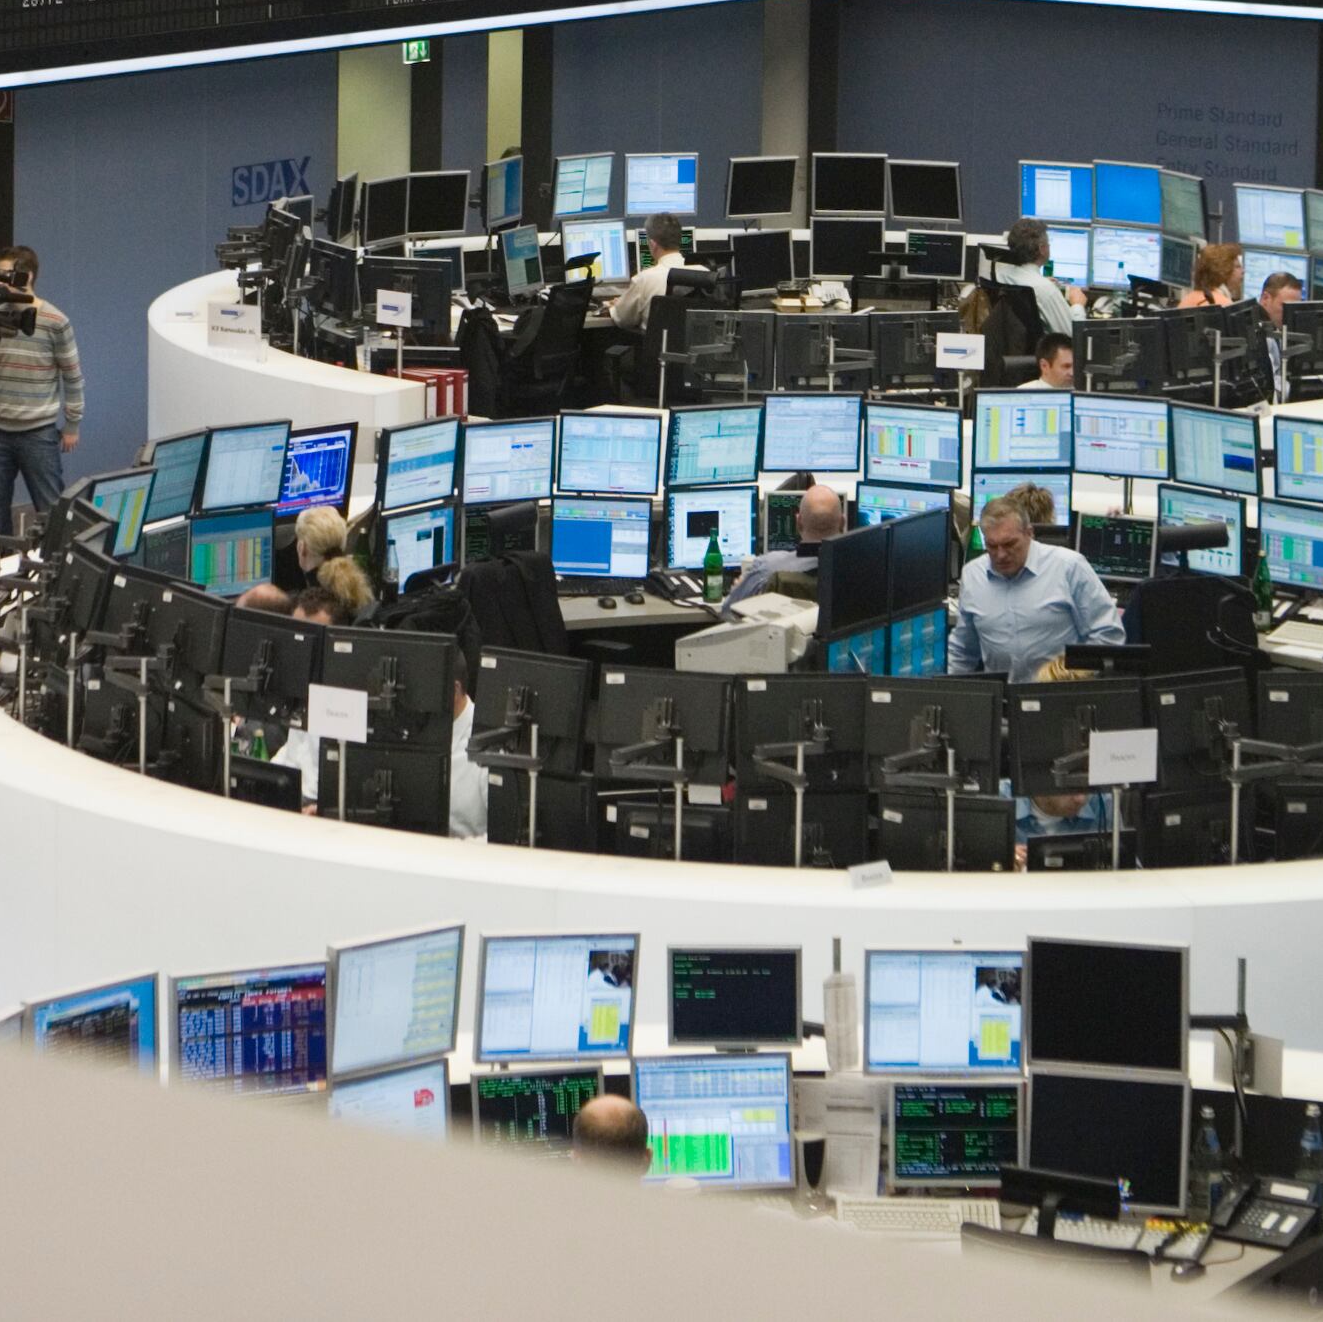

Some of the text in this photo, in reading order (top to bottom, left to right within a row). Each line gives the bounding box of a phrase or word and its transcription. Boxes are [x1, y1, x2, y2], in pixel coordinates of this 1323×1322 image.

[1157, 103, 1283, 127] Prime Standard
[1156, 130, 1298, 156] General Standard
[233, 156, 310, 206] SDAX
